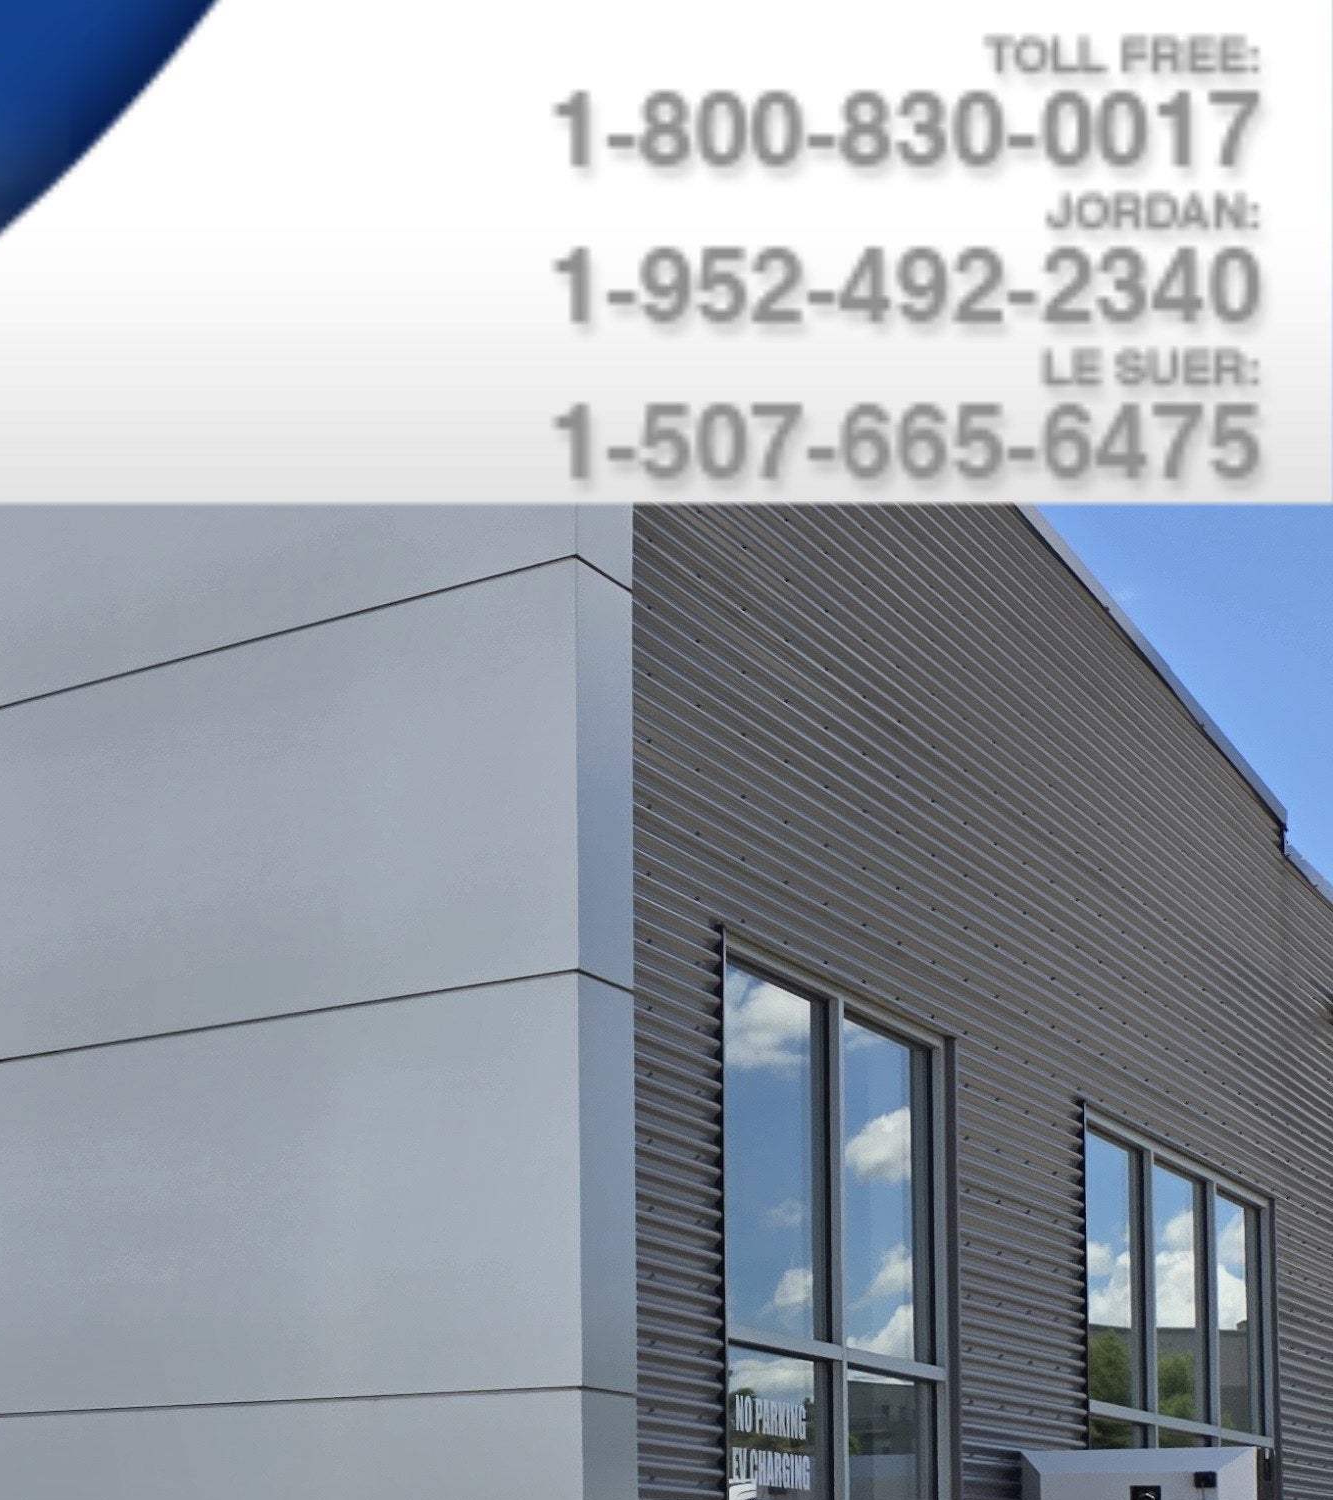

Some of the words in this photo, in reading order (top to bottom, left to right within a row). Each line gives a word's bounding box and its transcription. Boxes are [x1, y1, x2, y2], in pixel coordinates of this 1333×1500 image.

[735, 1395, 753, 1433] NO
[755, 1398, 807, 1440] PARKING
[749, 1448, 810, 1491] CHARGING
